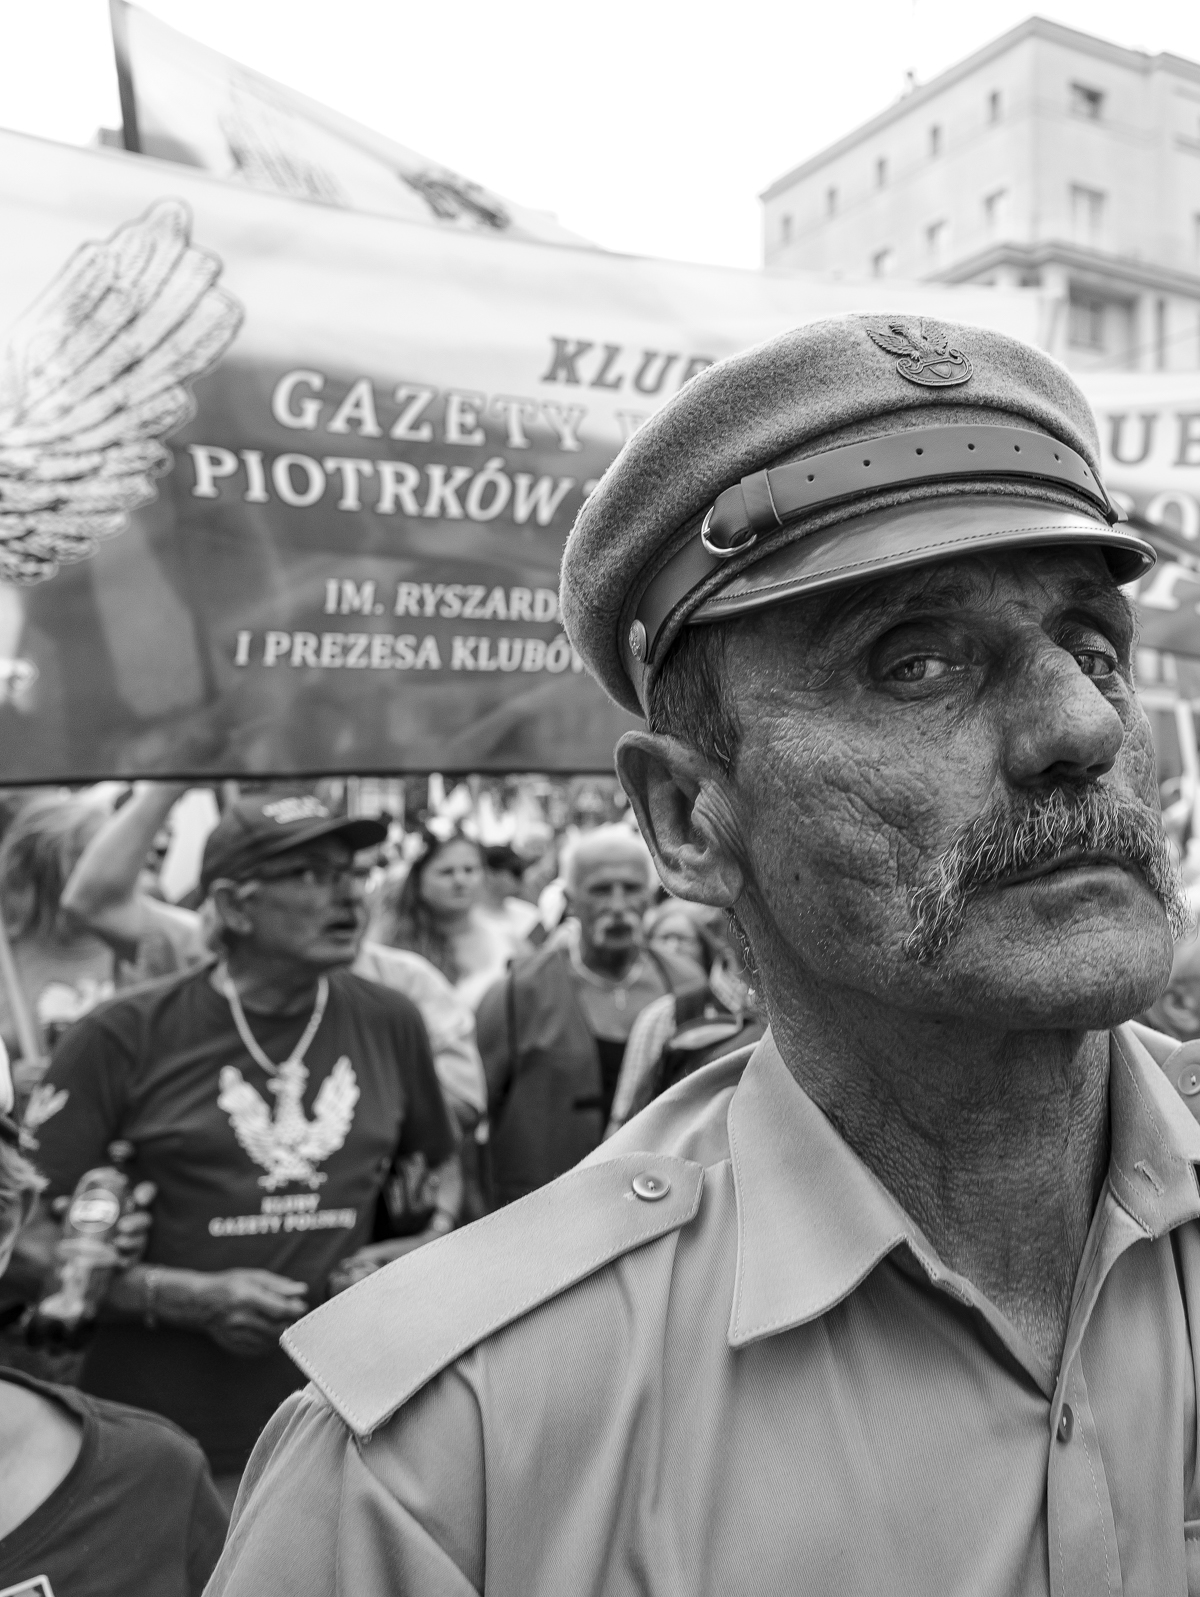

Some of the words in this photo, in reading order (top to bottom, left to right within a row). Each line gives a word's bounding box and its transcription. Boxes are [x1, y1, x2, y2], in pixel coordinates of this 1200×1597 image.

[271, 369, 588, 451] GAZETY
[188, 443, 575, 527] PIOTRKÓW
[324, 578, 386, 616] IM.
[395, 582, 563, 623] RYSZARD
[236, 630, 251, 667] I
[263, 631, 443, 671] PREZESA
